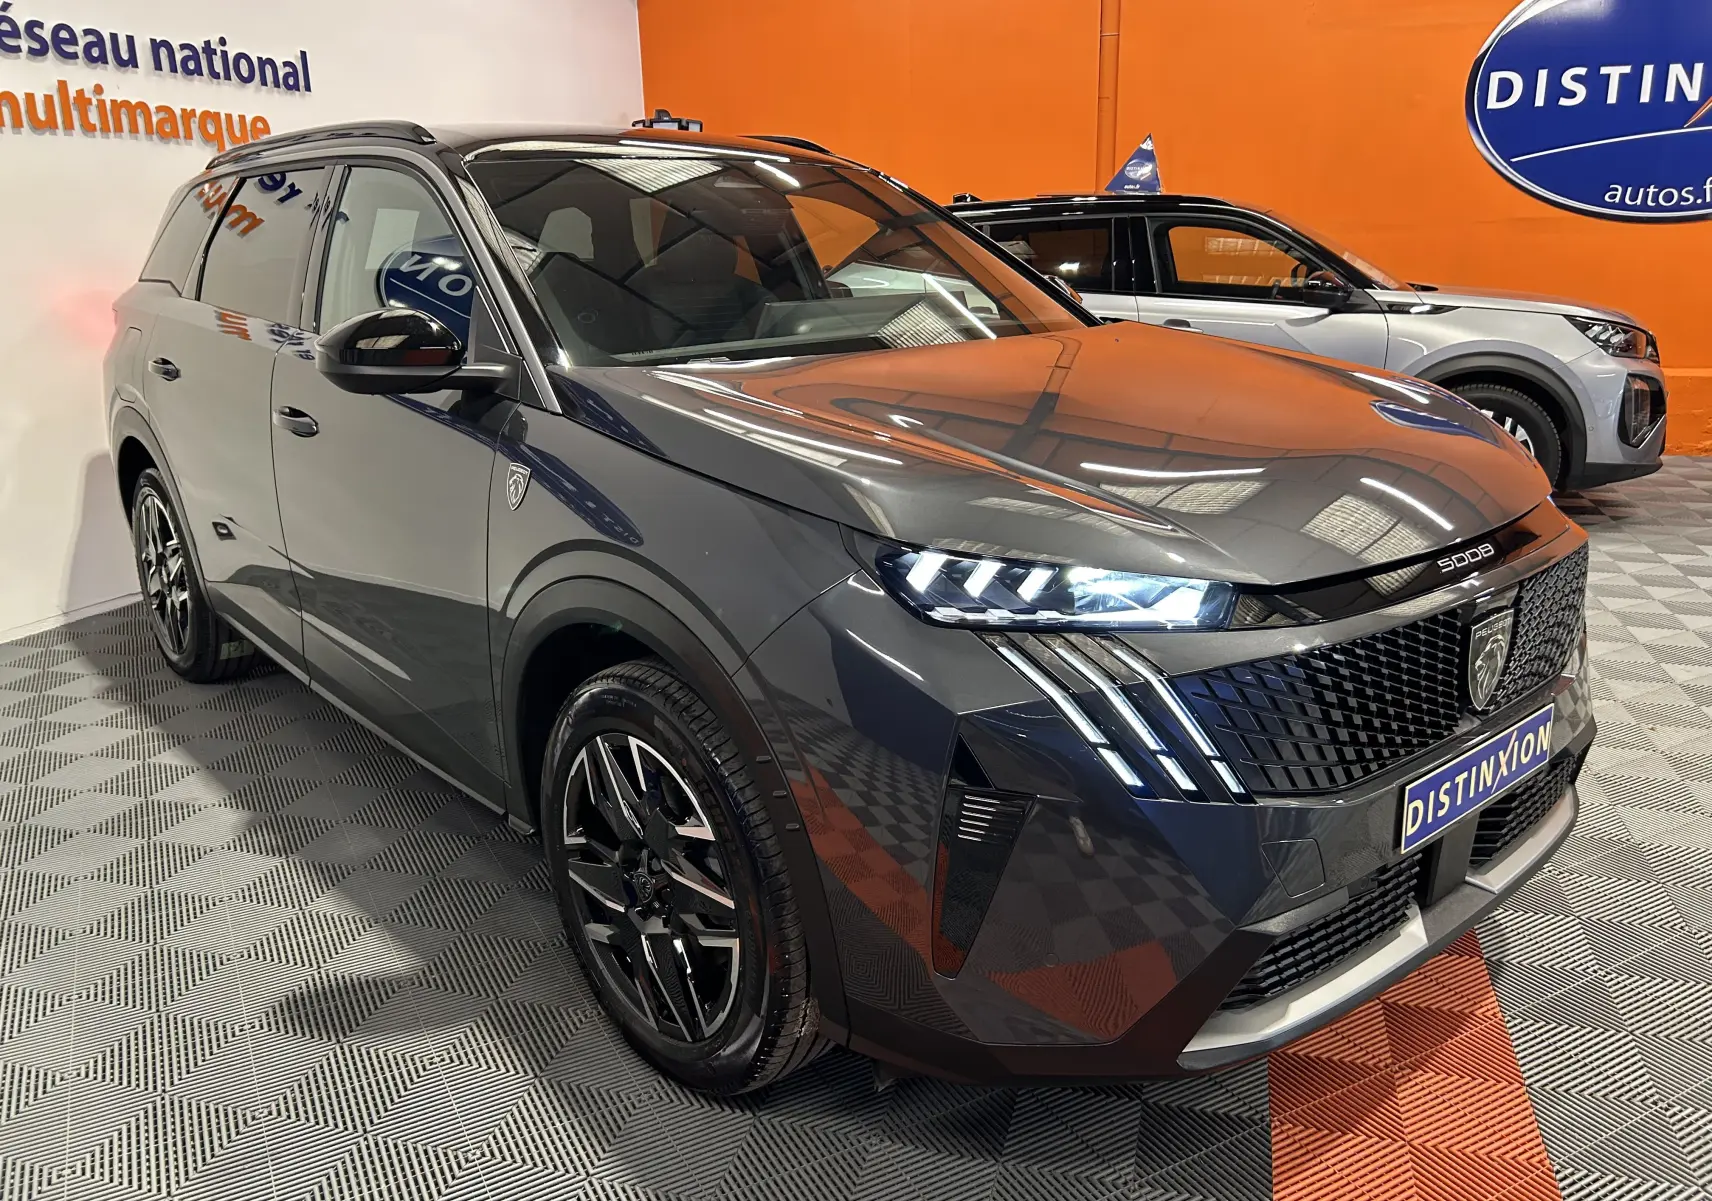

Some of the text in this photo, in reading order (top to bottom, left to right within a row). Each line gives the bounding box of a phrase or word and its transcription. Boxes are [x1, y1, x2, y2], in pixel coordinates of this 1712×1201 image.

[149, 36, 311, 92] national
[1486, 62, 1712, 114] DISTIN
[1437, 543, 1495, 573] 5008
[1475, 617, 1512, 639] PEUGEOT
[1405, 721, 1552, 837] DISTINXION
